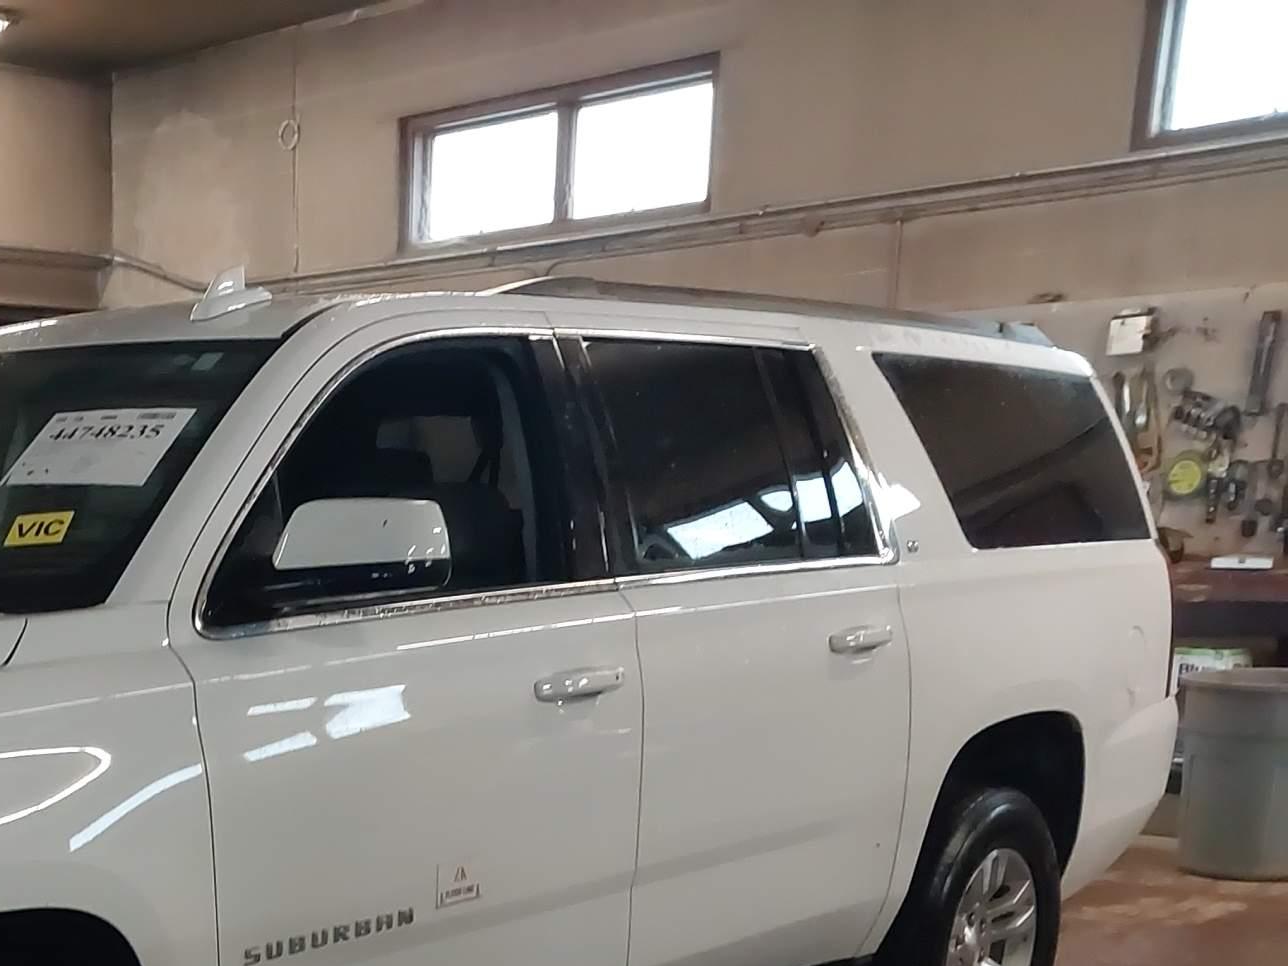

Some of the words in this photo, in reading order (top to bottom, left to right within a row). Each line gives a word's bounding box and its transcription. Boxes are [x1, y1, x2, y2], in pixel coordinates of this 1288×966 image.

[49, 423, 165, 440] 44748235
[18, 519, 65, 538] VIC
[243, 907, 414, 966] SUBURBAN
